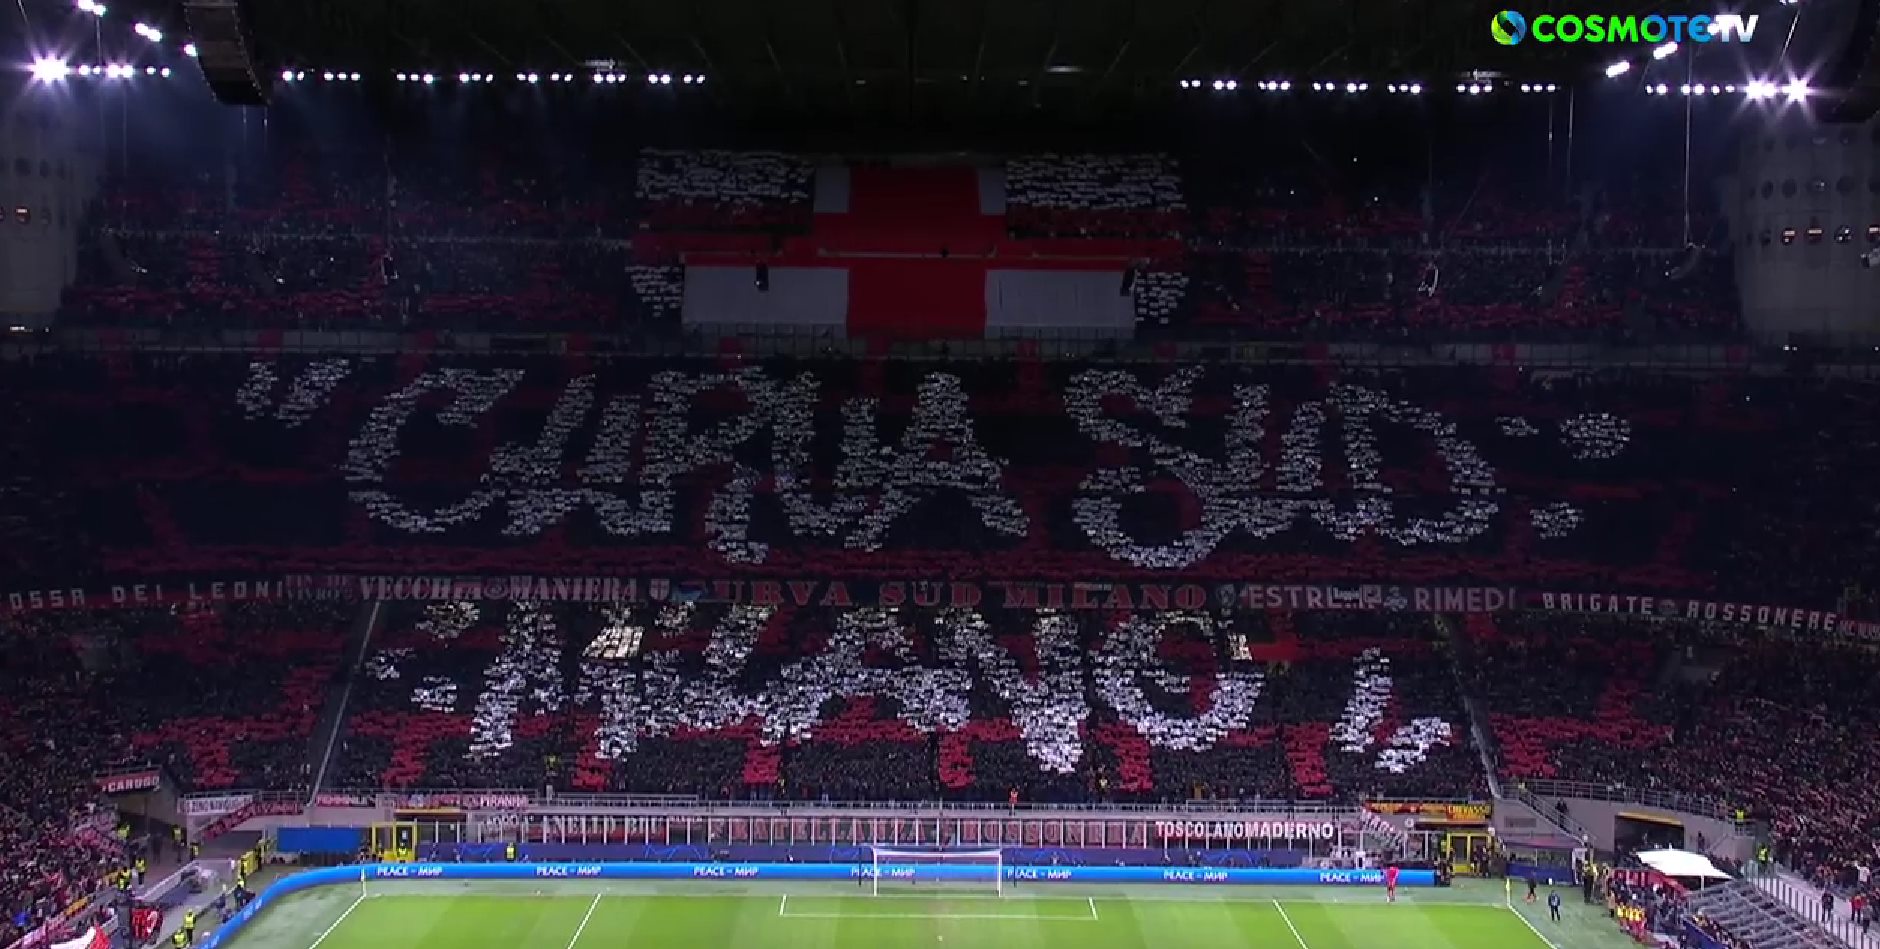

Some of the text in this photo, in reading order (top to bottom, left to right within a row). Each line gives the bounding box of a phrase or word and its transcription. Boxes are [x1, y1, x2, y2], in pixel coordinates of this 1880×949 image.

[111, 583, 163, 604] DEI
[188, 580, 284, 602] LEONI
[878, 582, 983, 607] SUD
[1001, 582, 1208, 610] MILANO
[1541, 592, 1655, 616] BRIGATE
[1685, 600, 1839, 632] ROSSONERE
